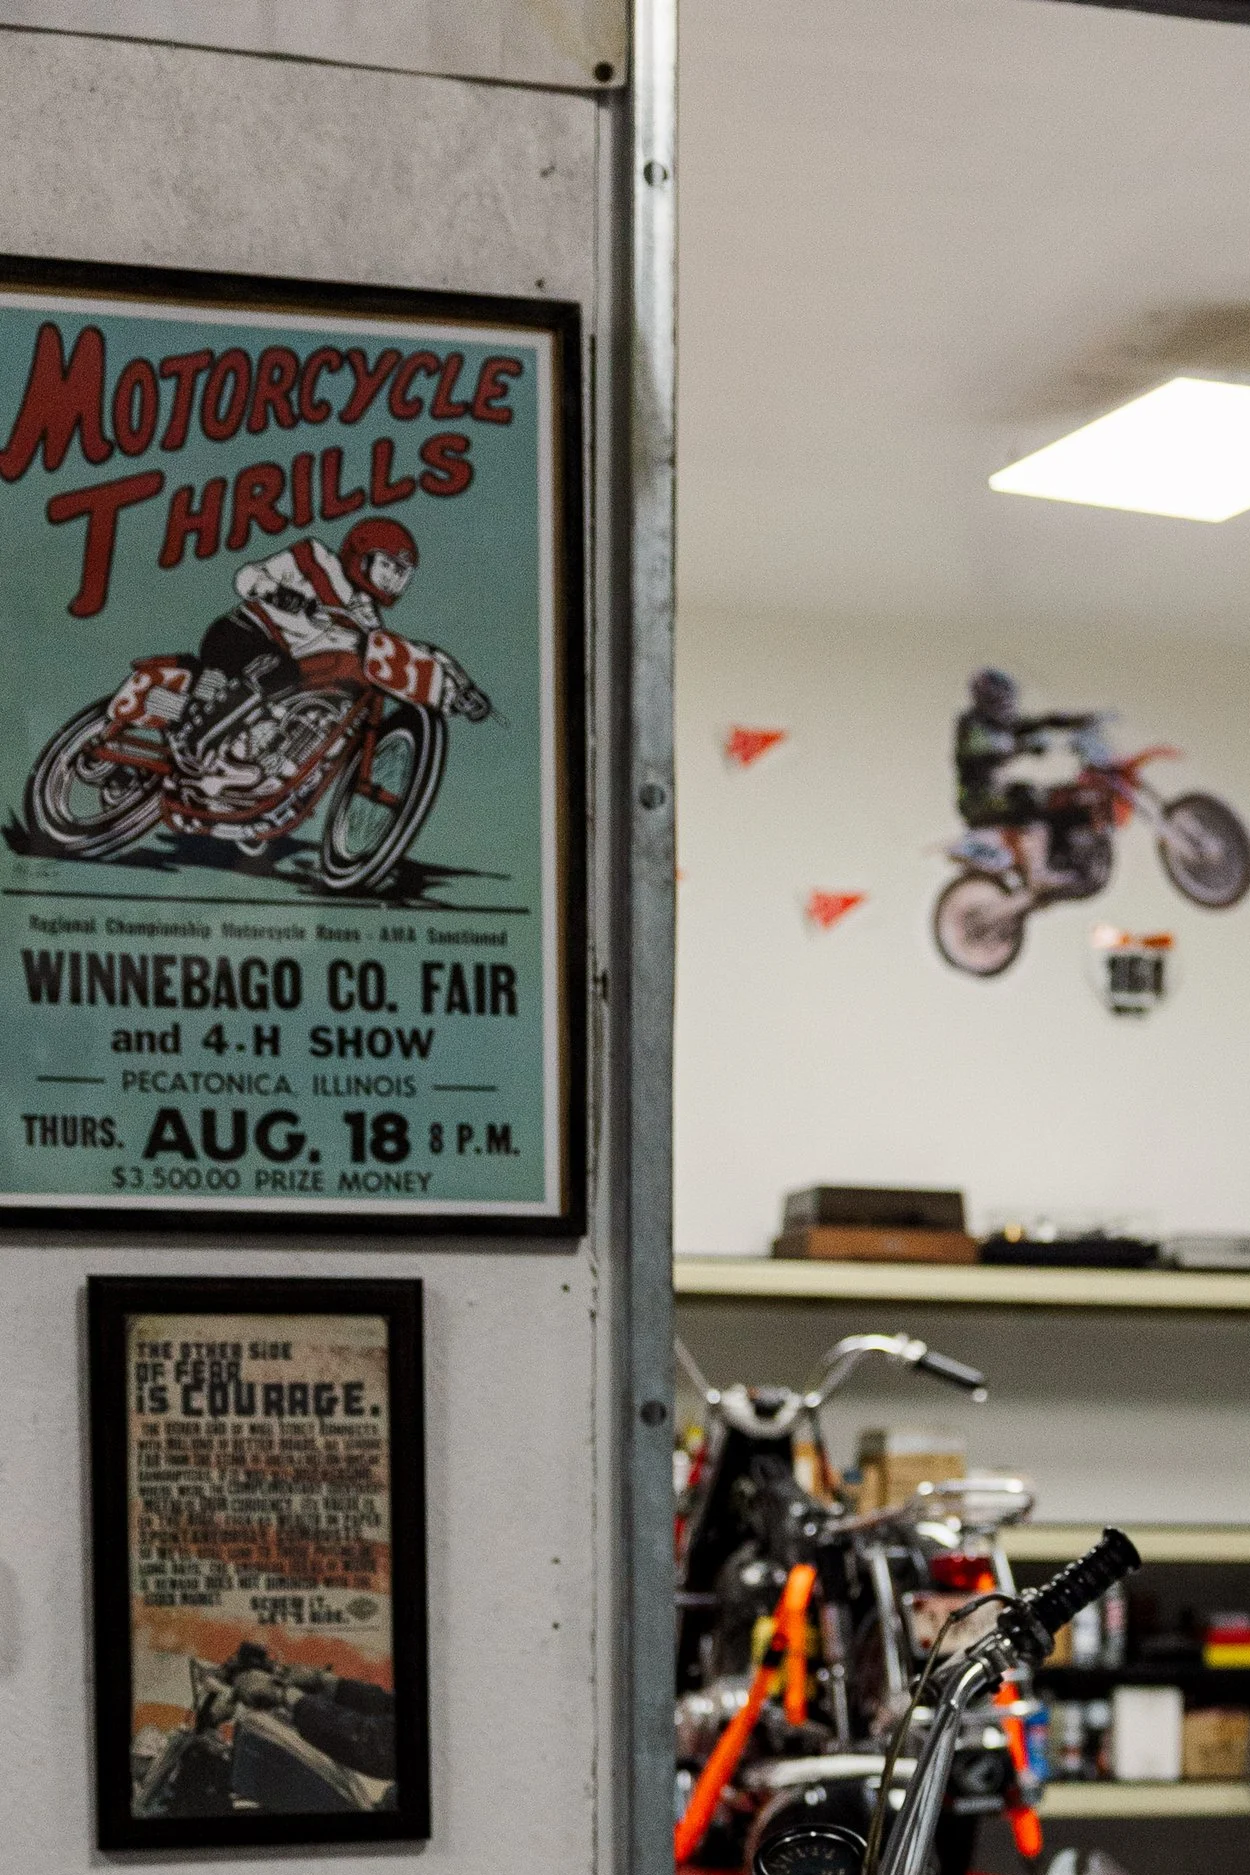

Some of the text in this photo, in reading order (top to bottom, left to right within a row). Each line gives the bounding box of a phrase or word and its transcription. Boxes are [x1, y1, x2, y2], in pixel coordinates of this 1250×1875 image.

[0, 321, 523, 482] MOTORCYCLE
[47, 433, 475, 618] THRILLS
[367, 631, 435, 706] 31
[105, 916, 212, 939] Championship
[21, 948, 519, 1016] WINNEBAGO CO. FAIR
[111, 1024, 182, 1055] and
[309, 1026, 436, 1060] SHOW
[312, 1074, 417, 1098] ILLINOIS
[21, 1107, 521, 1164] THURS. AUG. 18 8 P.M.
[255, 1168, 325, 1191] PRIZE
[338, 1170, 433, 1193] MONEY
[182, 1381, 381, 1417] COURAGE.
